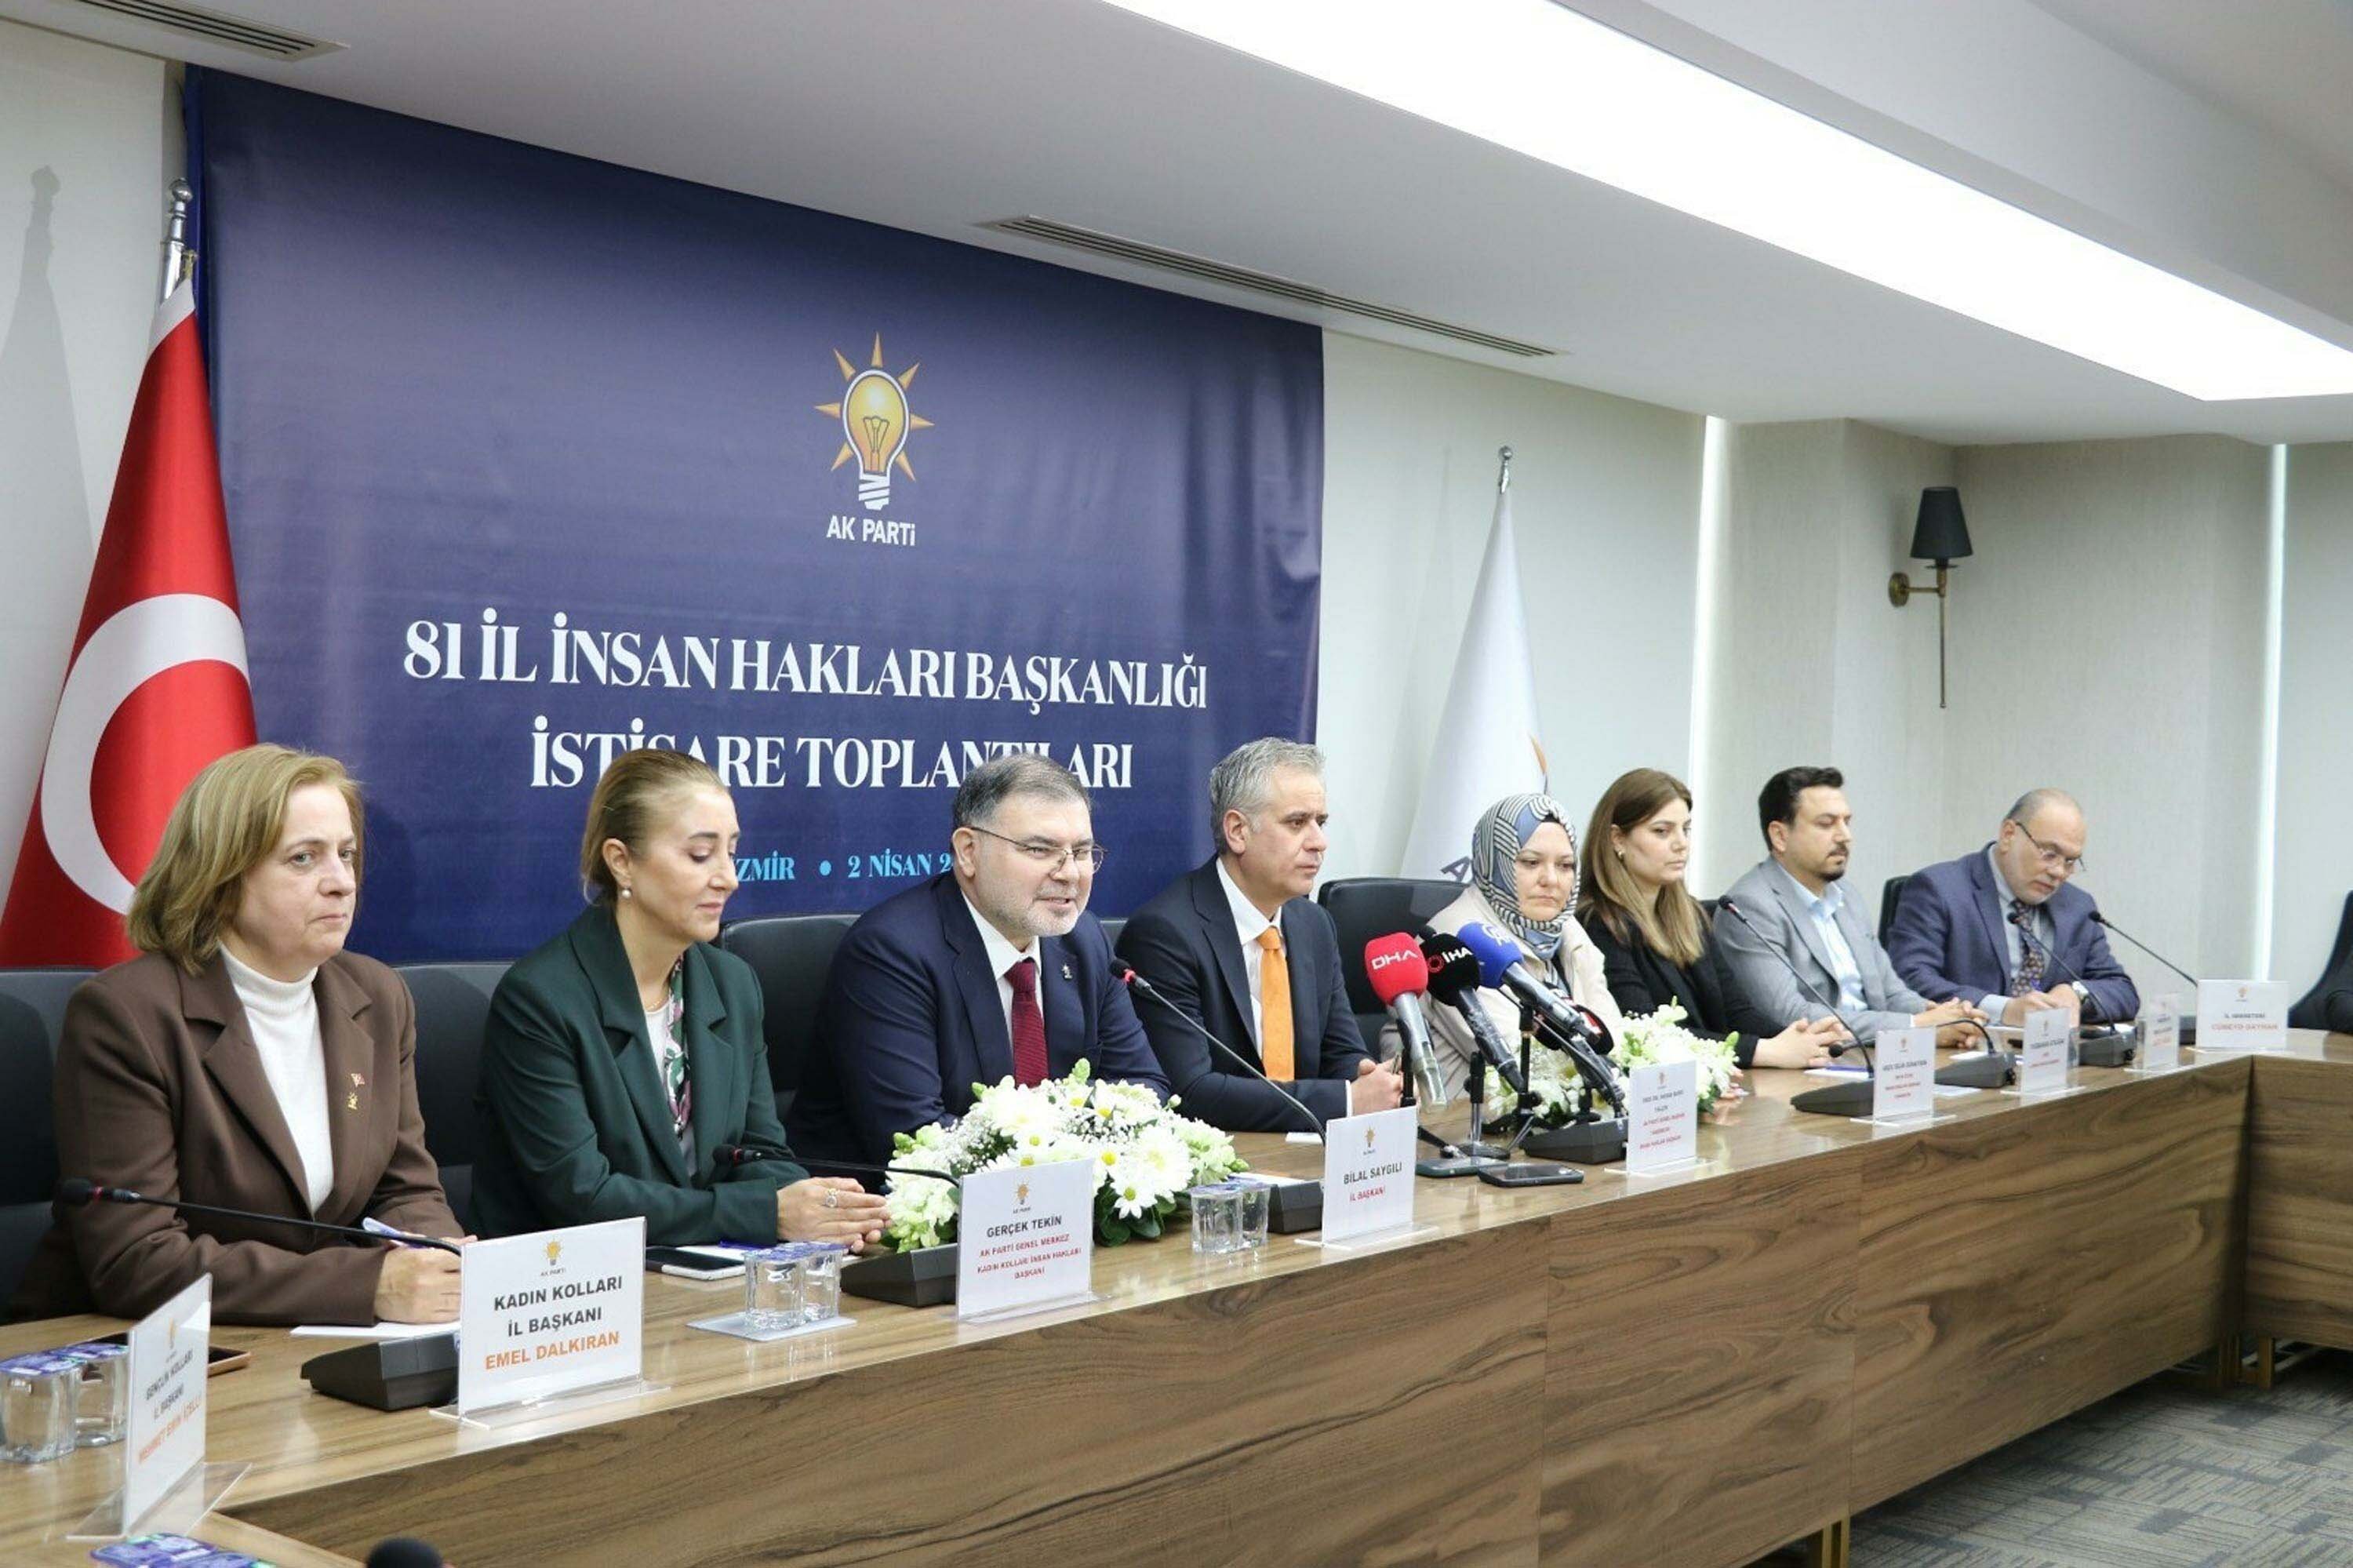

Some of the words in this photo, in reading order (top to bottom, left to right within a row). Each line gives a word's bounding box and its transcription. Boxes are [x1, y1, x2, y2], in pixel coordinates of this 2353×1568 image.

[826, 515, 856, 540] AK
[863, 518, 915, 546] PARTİ
[404, 620, 465, 680] 81
[479, 607, 537, 682] İL
[550, 611, 719, 689] İNSAN
[730, 638, 956, 699] HAKLARI
[966, 652, 1206, 715] BAŞKANLIĞI
[734, 849, 795, 882] ZMİR
[848, 855, 861, 878] 2
[868, 848, 932, 877] NİSAN
[1371, 949, 1418, 970] DHA
[1344, 1170, 1368, 1184] BİLAL
[1370, 1162, 1402, 1178] SAYGILI
[987, 1222, 1028, 1239] GERÇEK
[1031, 1215, 1062, 1229] TEKİN
[494, 1289, 547, 1312] KADIN
[552, 1275, 622, 1301] KOLLARI
[508, 1320, 523, 1337] İL
[529, 1306, 602, 1333] BAŞKANI
[486, 1348, 531, 1370] EMEL
[536, 1331, 620, 1360] DALKIRAN
